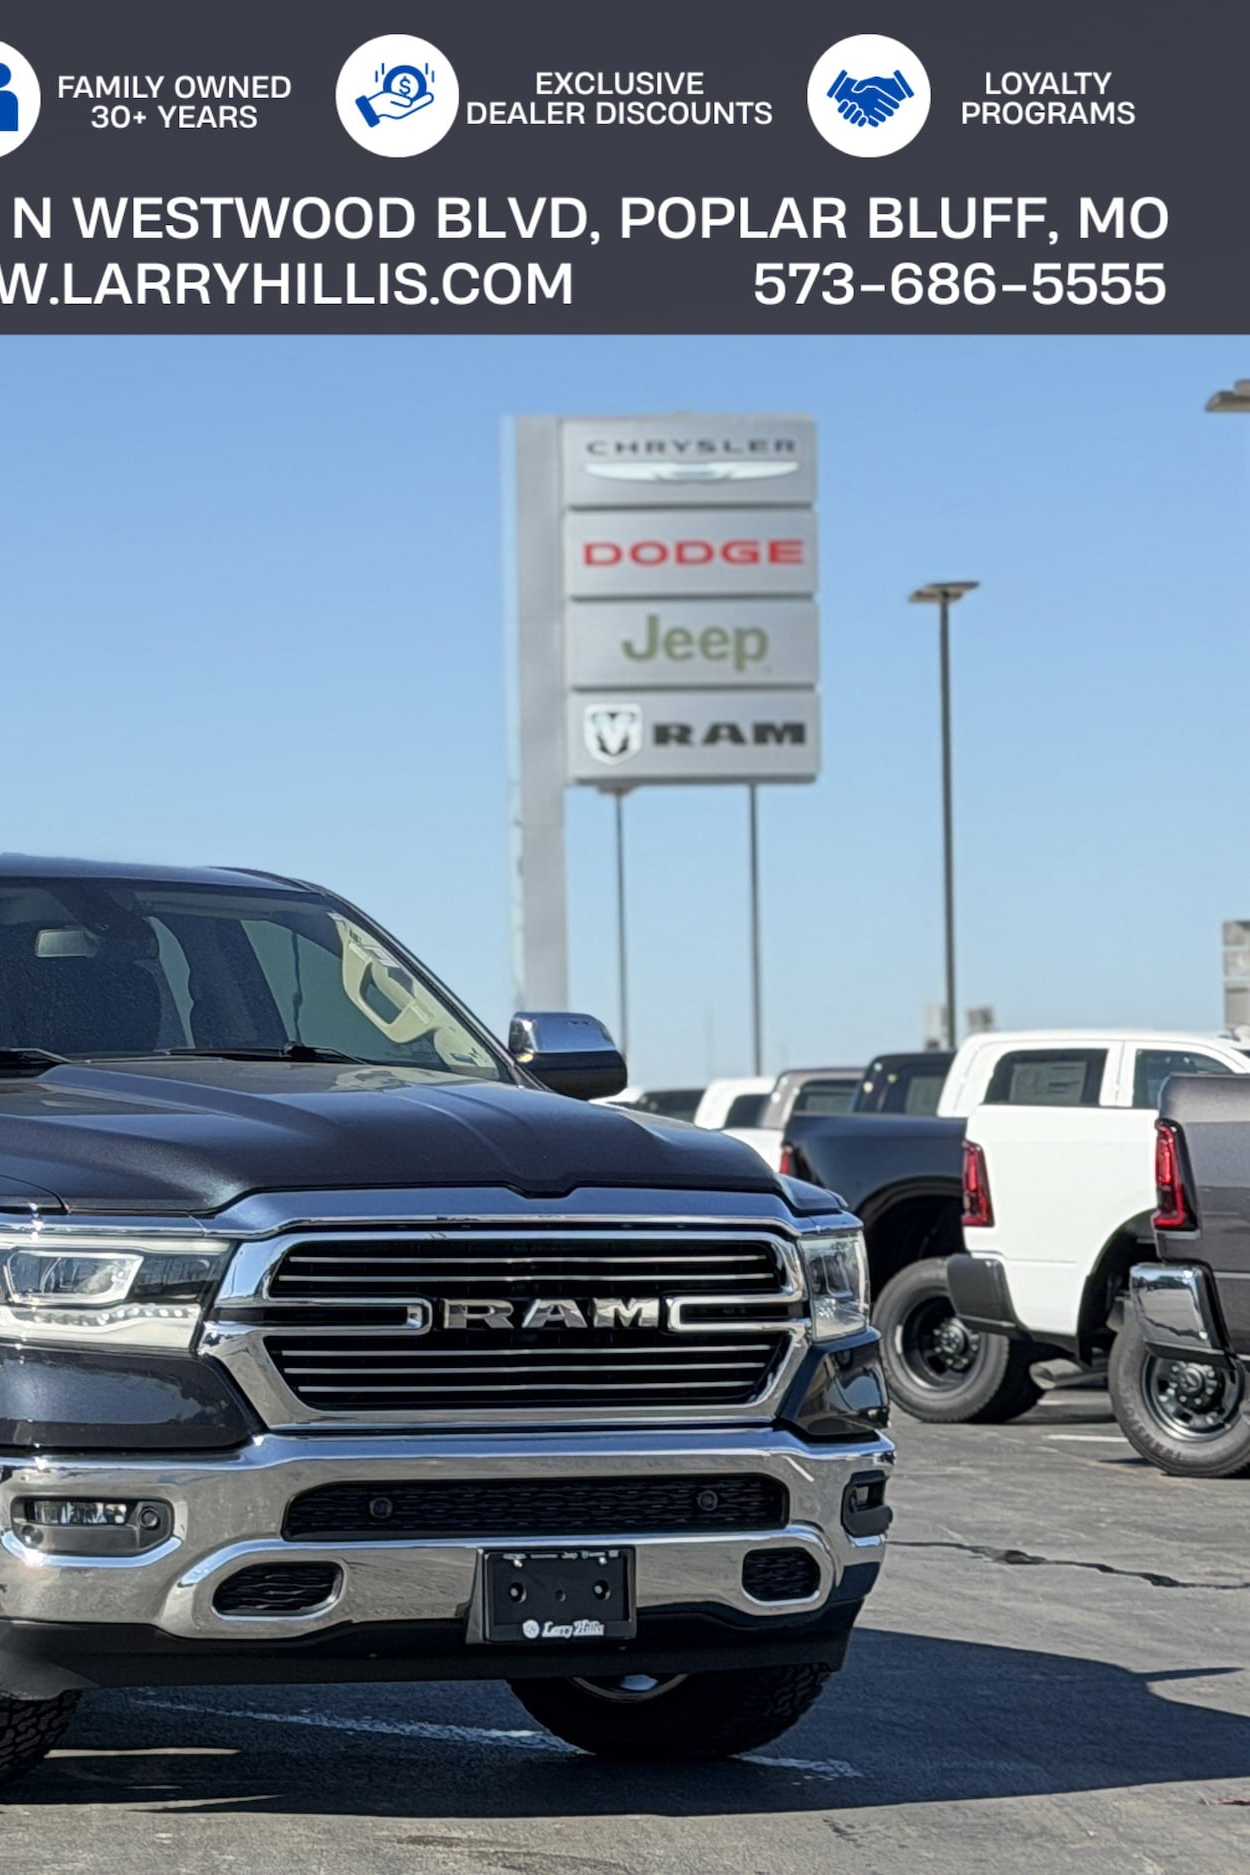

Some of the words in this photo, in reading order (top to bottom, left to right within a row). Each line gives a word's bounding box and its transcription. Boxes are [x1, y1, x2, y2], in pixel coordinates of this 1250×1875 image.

[586, 439, 796, 454] CHRYSLER
[584, 540, 804, 566] DODGE
[621, 614, 768, 672] Jeep
[653, 722, 807, 746] RAM
[443, 1297, 660, 1329] RAM
